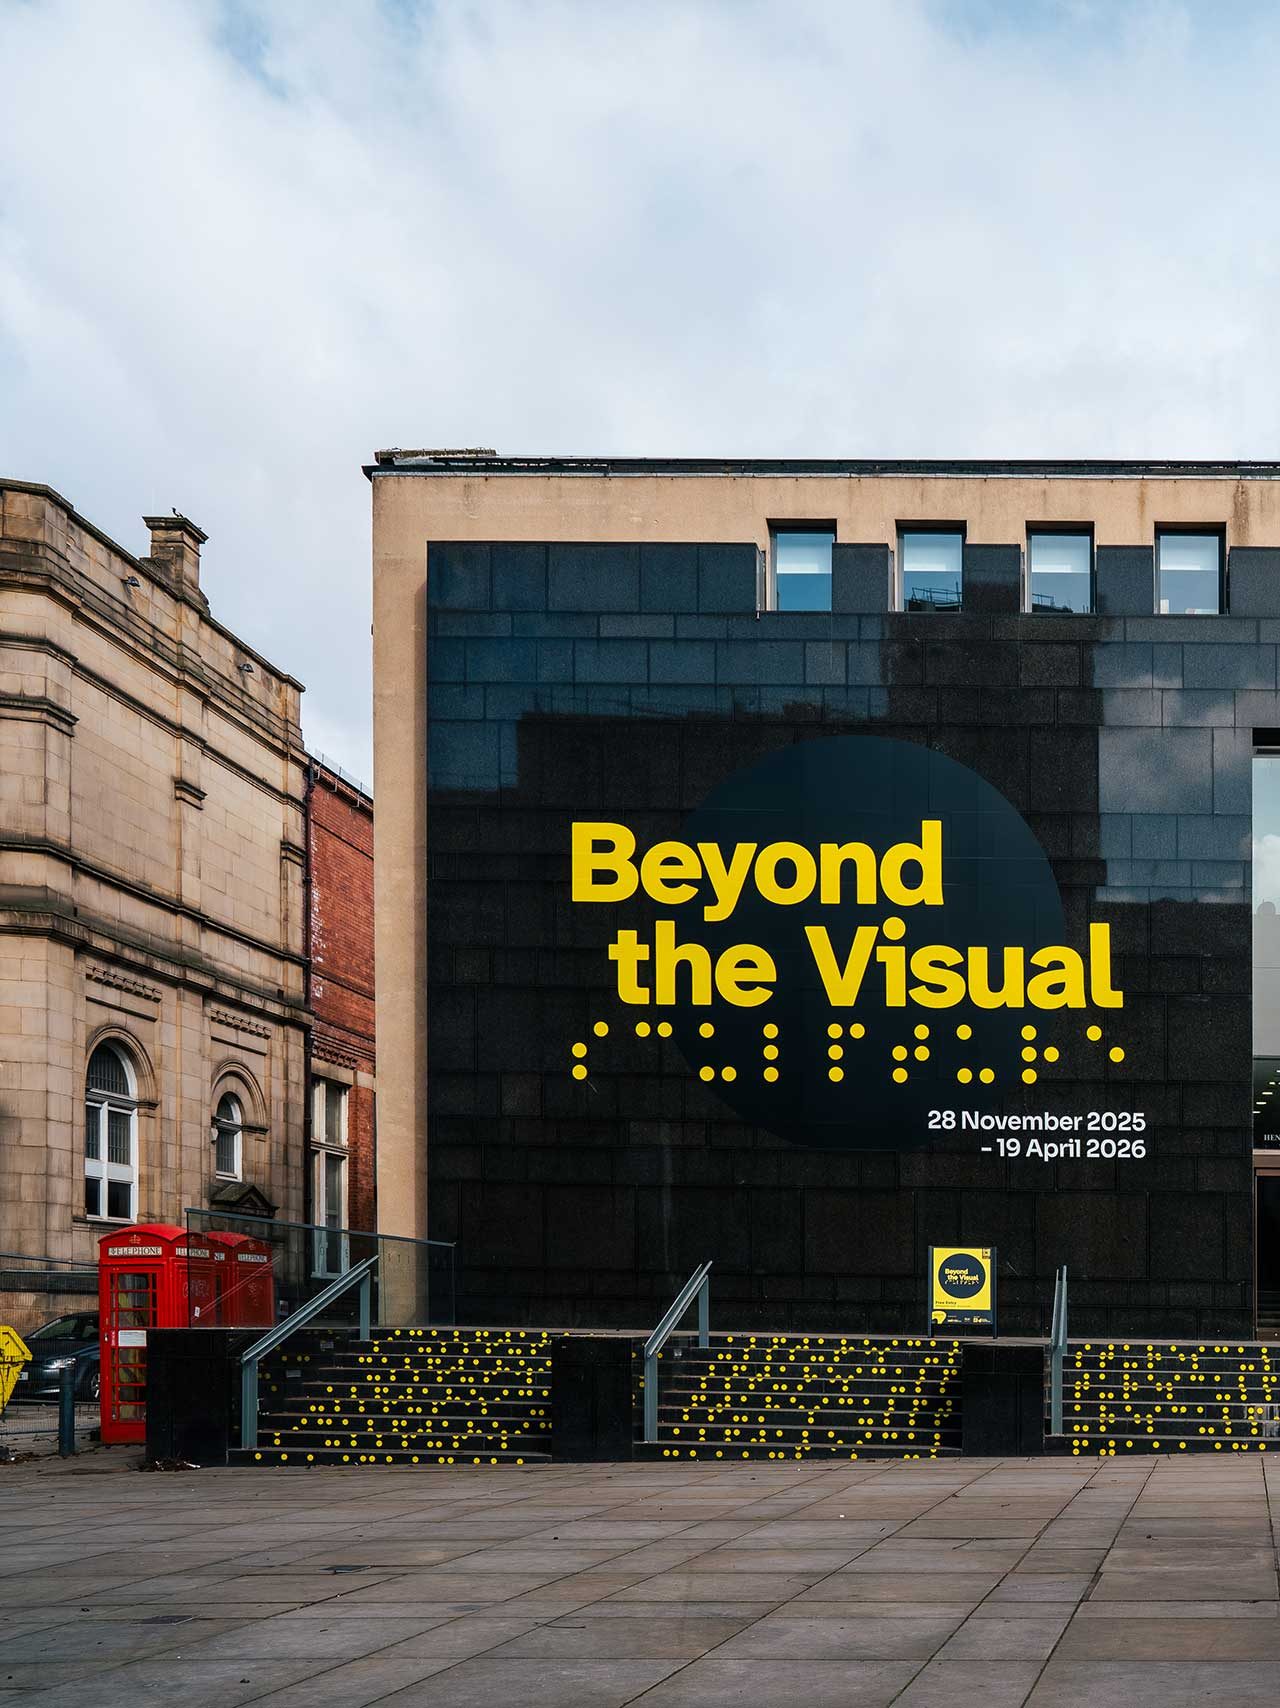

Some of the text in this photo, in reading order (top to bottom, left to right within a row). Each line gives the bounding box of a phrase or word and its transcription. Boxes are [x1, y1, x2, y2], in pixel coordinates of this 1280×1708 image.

[572, 820, 944, 922] Beyond
[609, 917, 1124, 1009] the Visual
[927, 1110, 1146, 1132] 28 November 2025
[996, 1137, 1021, 1157] 19
[1025, 1138, 1081, 1162] April
[1086, 1138, 1146, 1159] 2026
[110, 1247, 161, 1256] TELEPHONE
[945, 1268, 969, 1276] Beyond
